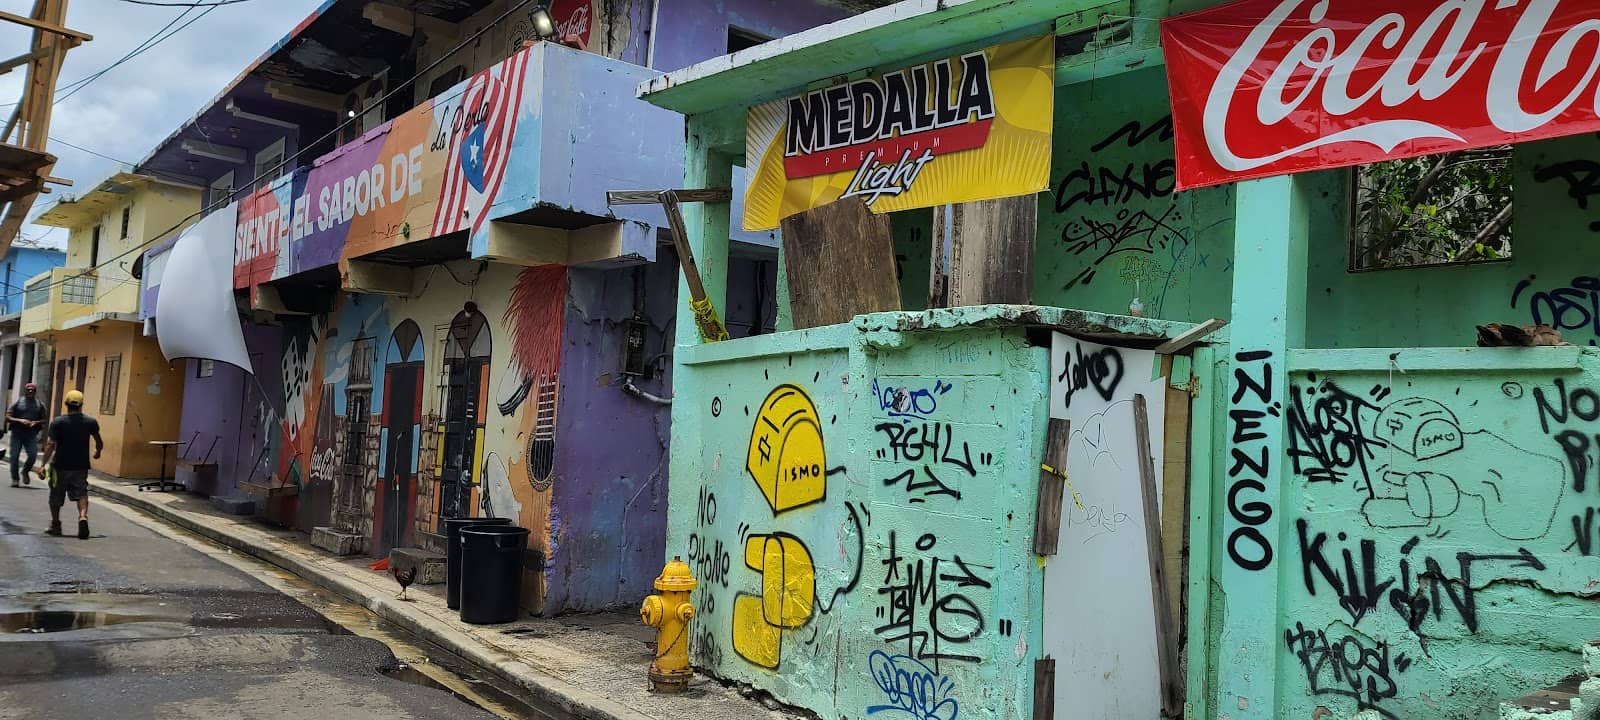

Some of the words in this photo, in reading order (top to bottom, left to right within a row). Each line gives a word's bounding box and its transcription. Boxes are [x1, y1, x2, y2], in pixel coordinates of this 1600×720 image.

[785, 51, 996, 156] MEDALLA
[1203, 0, 1600, 171] Coca-C
[431, 105, 449, 152] La
[450, 84, 489, 143] Perla
[825, 137, 941, 167] PREMIUM
[840, 149, 935, 206] Light
[234, 206, 290, 266] SIENTE
[292, 192, 313, 241] EL
[318, 164, 385, 232] SABOR
[390, 143, 423, 204] DE
[1533, 378, 1600, 434] NO
[1421, 432, 1455, 447] ISMO
[1554, 429, 1600, 493] P
[784, 464, 820, 482] ISMO
[697, 484, 717, 529] NO
[1570, 506, 1600, 557] V
